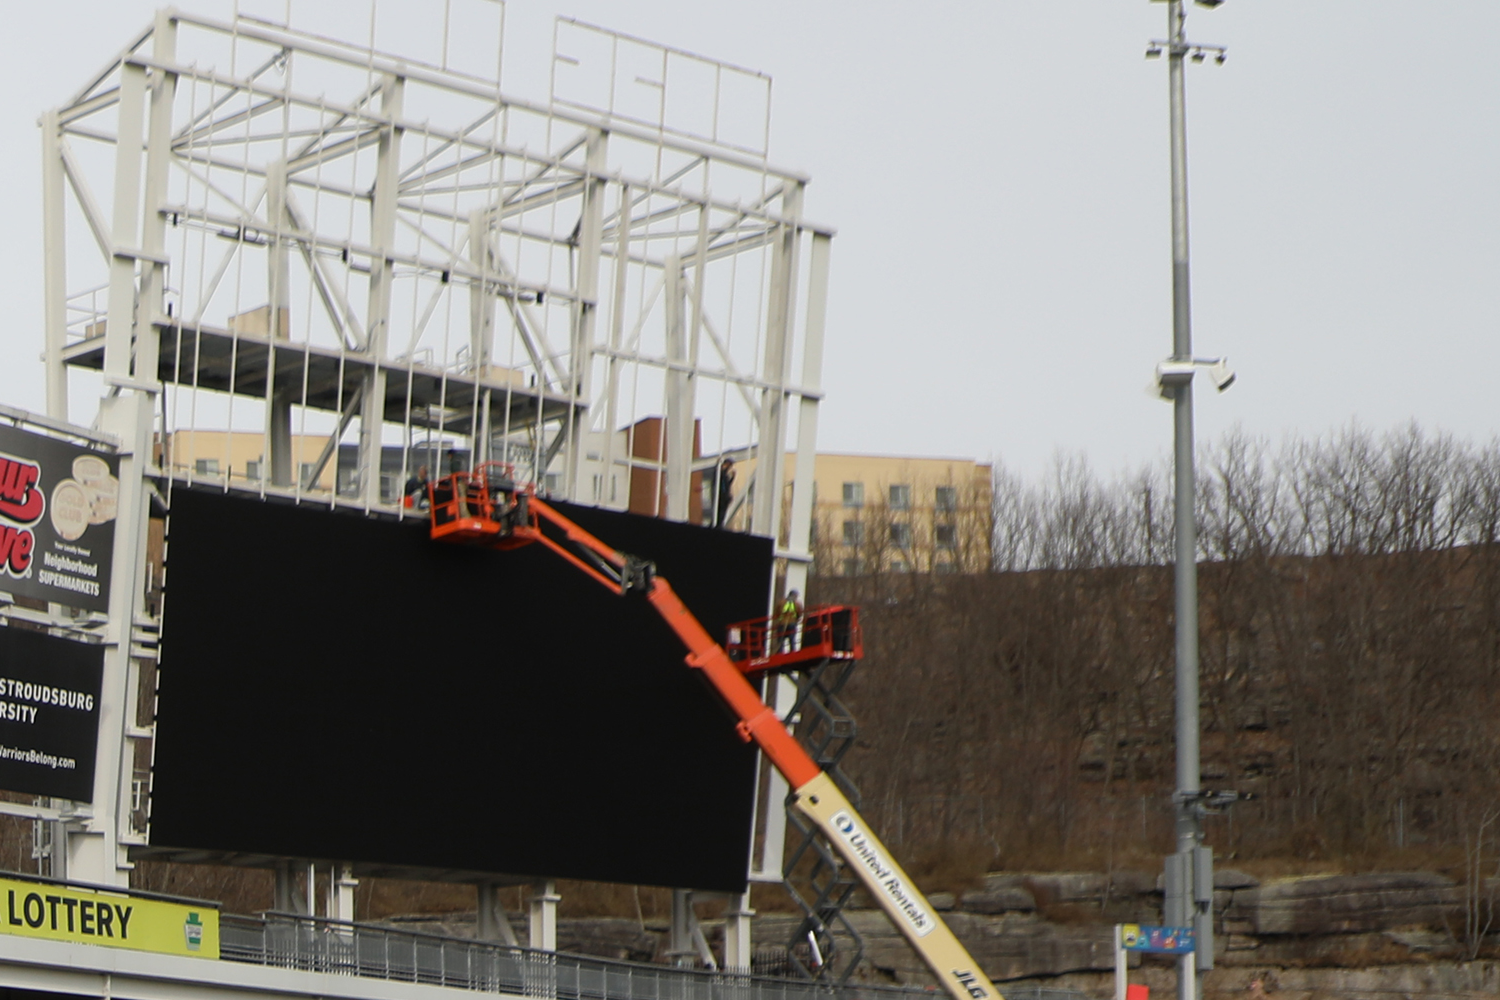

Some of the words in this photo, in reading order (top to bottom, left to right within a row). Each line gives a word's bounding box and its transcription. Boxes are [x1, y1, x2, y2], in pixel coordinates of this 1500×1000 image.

[44, 552, 98, 577] Neighborhood
[38, 569, 100, 596] SUPERMARKETS
[850, 833, 891, 879] United
[884, 877, 926, 928] Rentals
[8, 890, 133, 940] LOTTERY
[951, 967, 989, 1000] JLG
